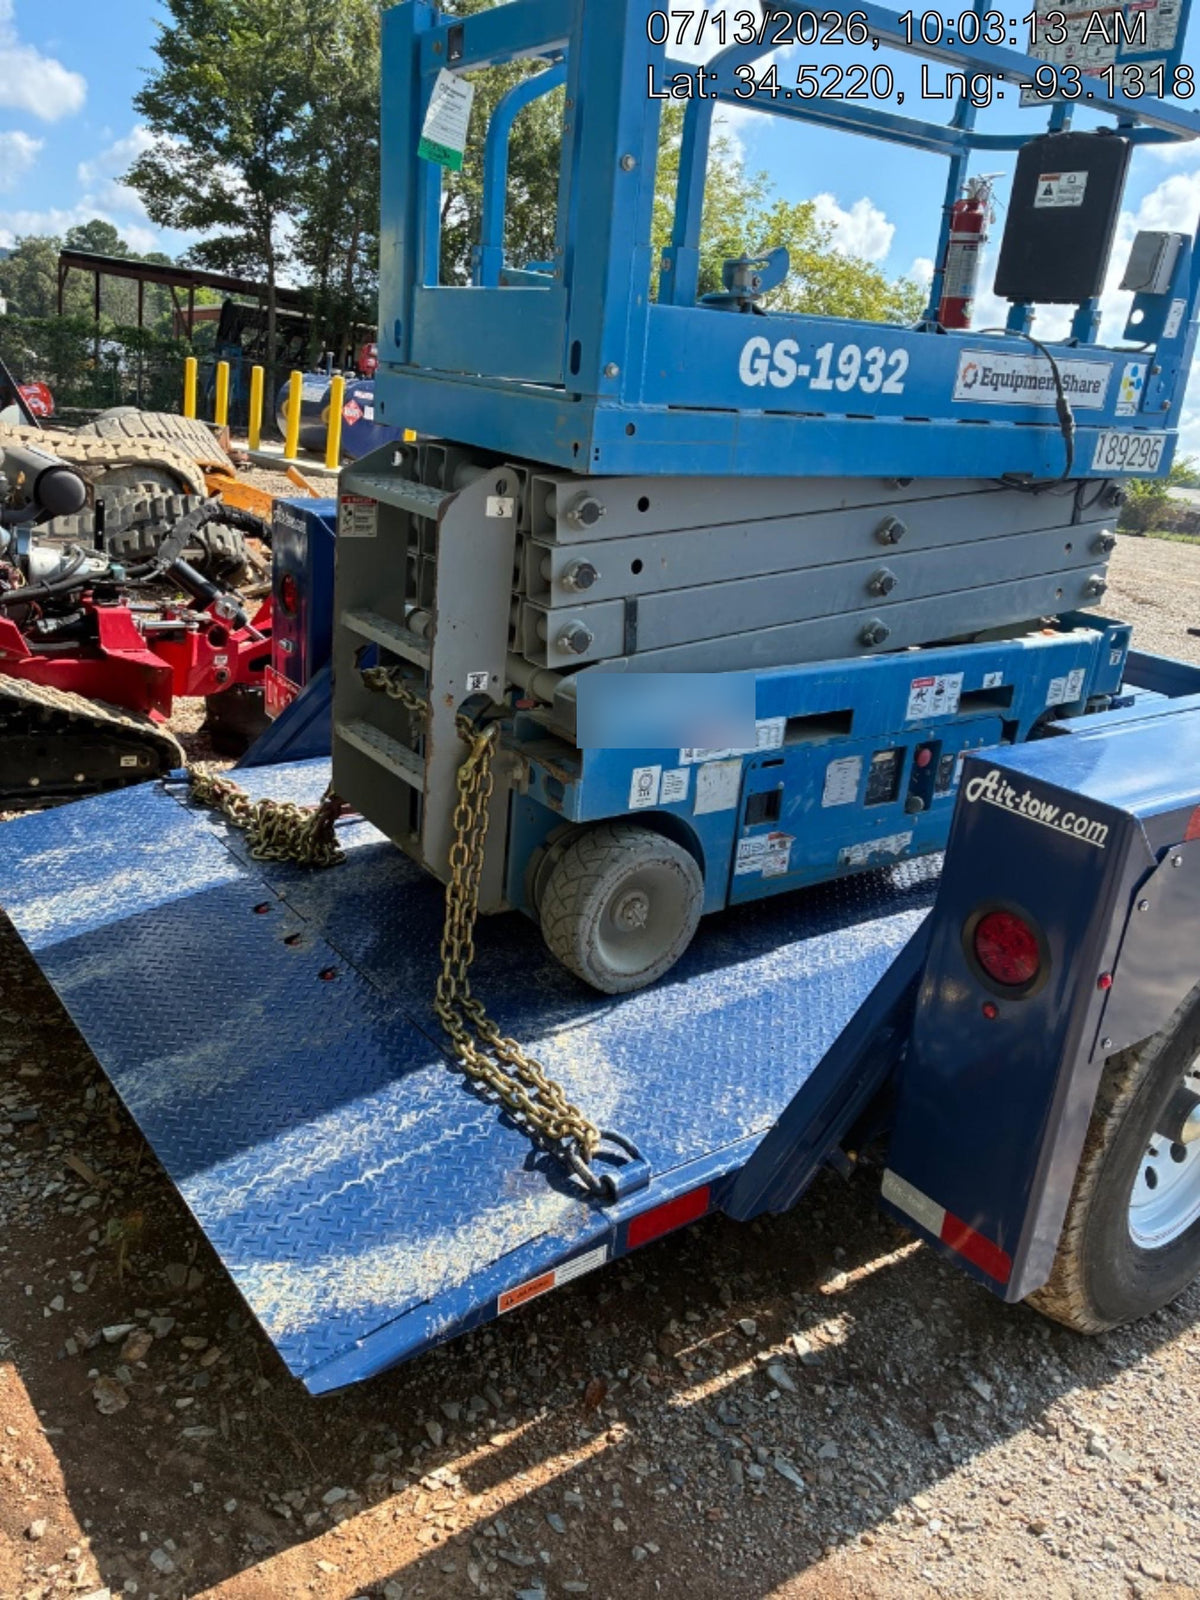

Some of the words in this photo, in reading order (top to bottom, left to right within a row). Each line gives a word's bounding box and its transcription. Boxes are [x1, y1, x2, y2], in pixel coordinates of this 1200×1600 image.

[738, 335, 910, 394] GS-1932
[980, 366, 1102, 394] EquipmenShare
[1096, 433, 1162, 469] 189296
[965, 769, 1109, 846] Air-tow.com
